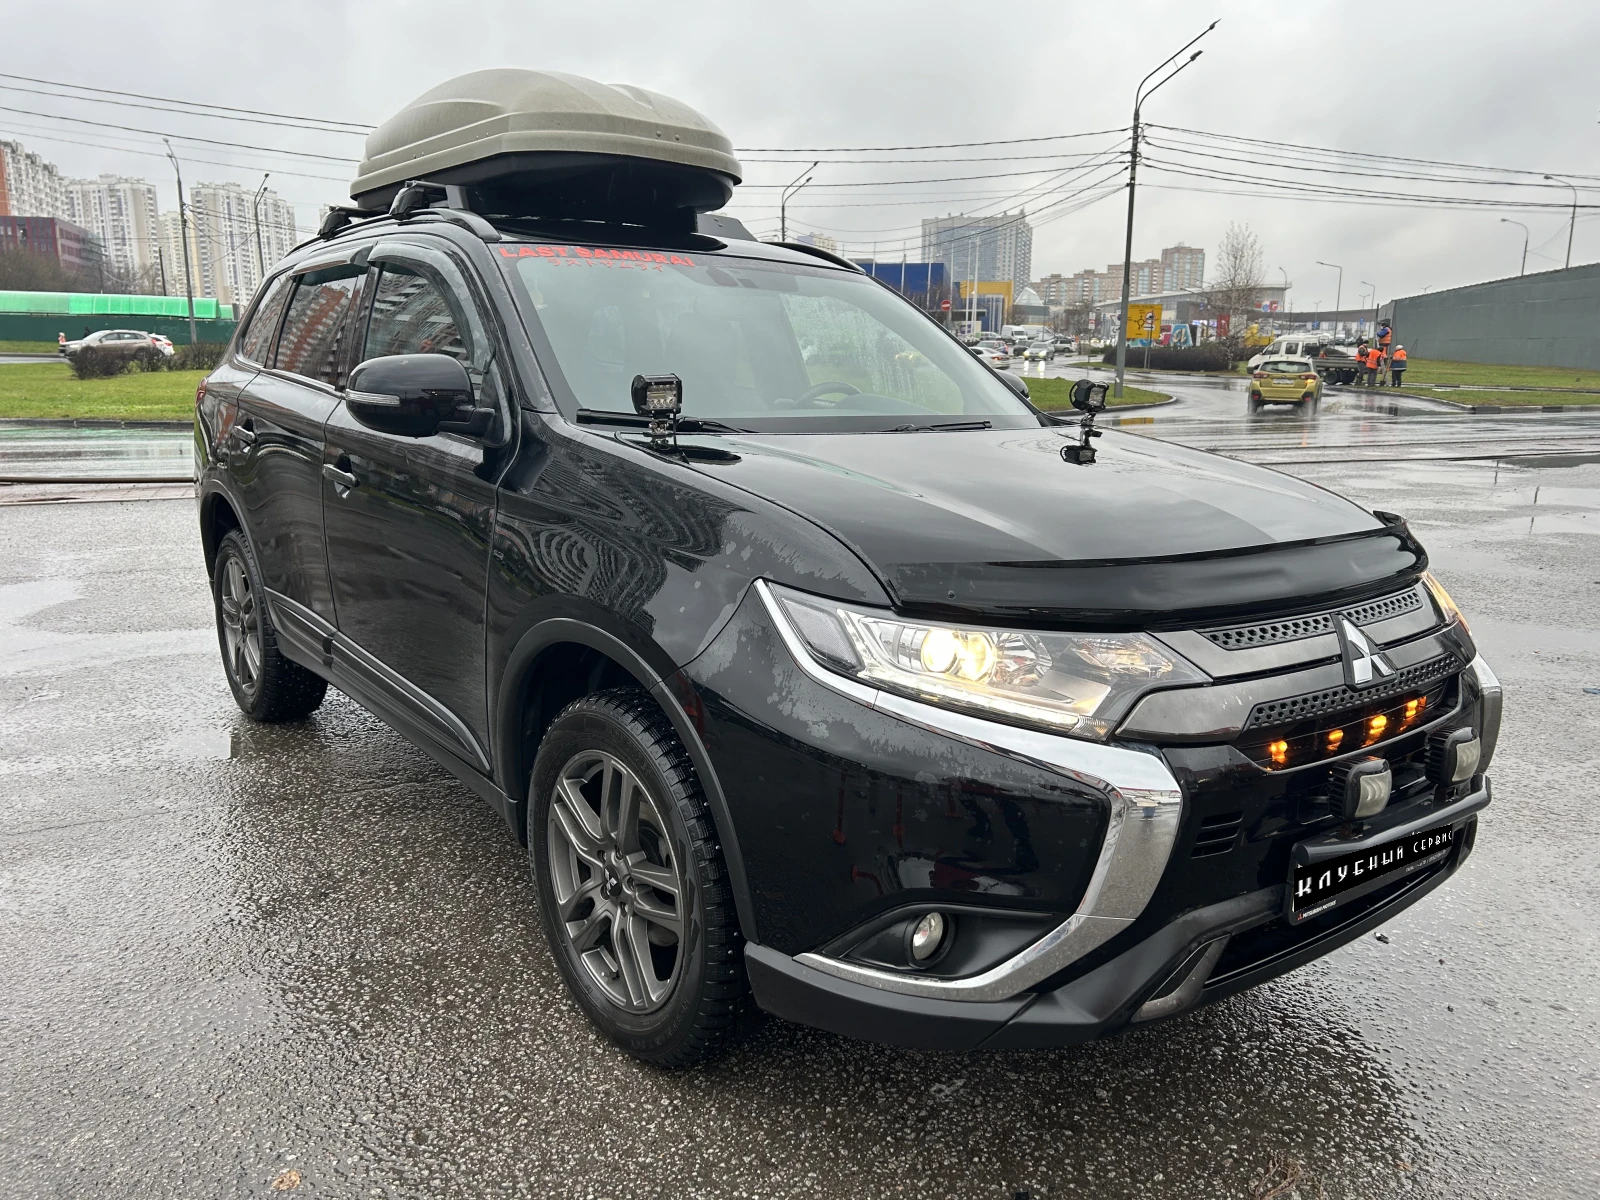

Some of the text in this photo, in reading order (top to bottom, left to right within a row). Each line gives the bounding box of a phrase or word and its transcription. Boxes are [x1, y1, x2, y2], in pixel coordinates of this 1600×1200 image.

[500, 246, 695, 267] LAST SAMURAI
[548, 258, 663, 272] ラストサムライ
